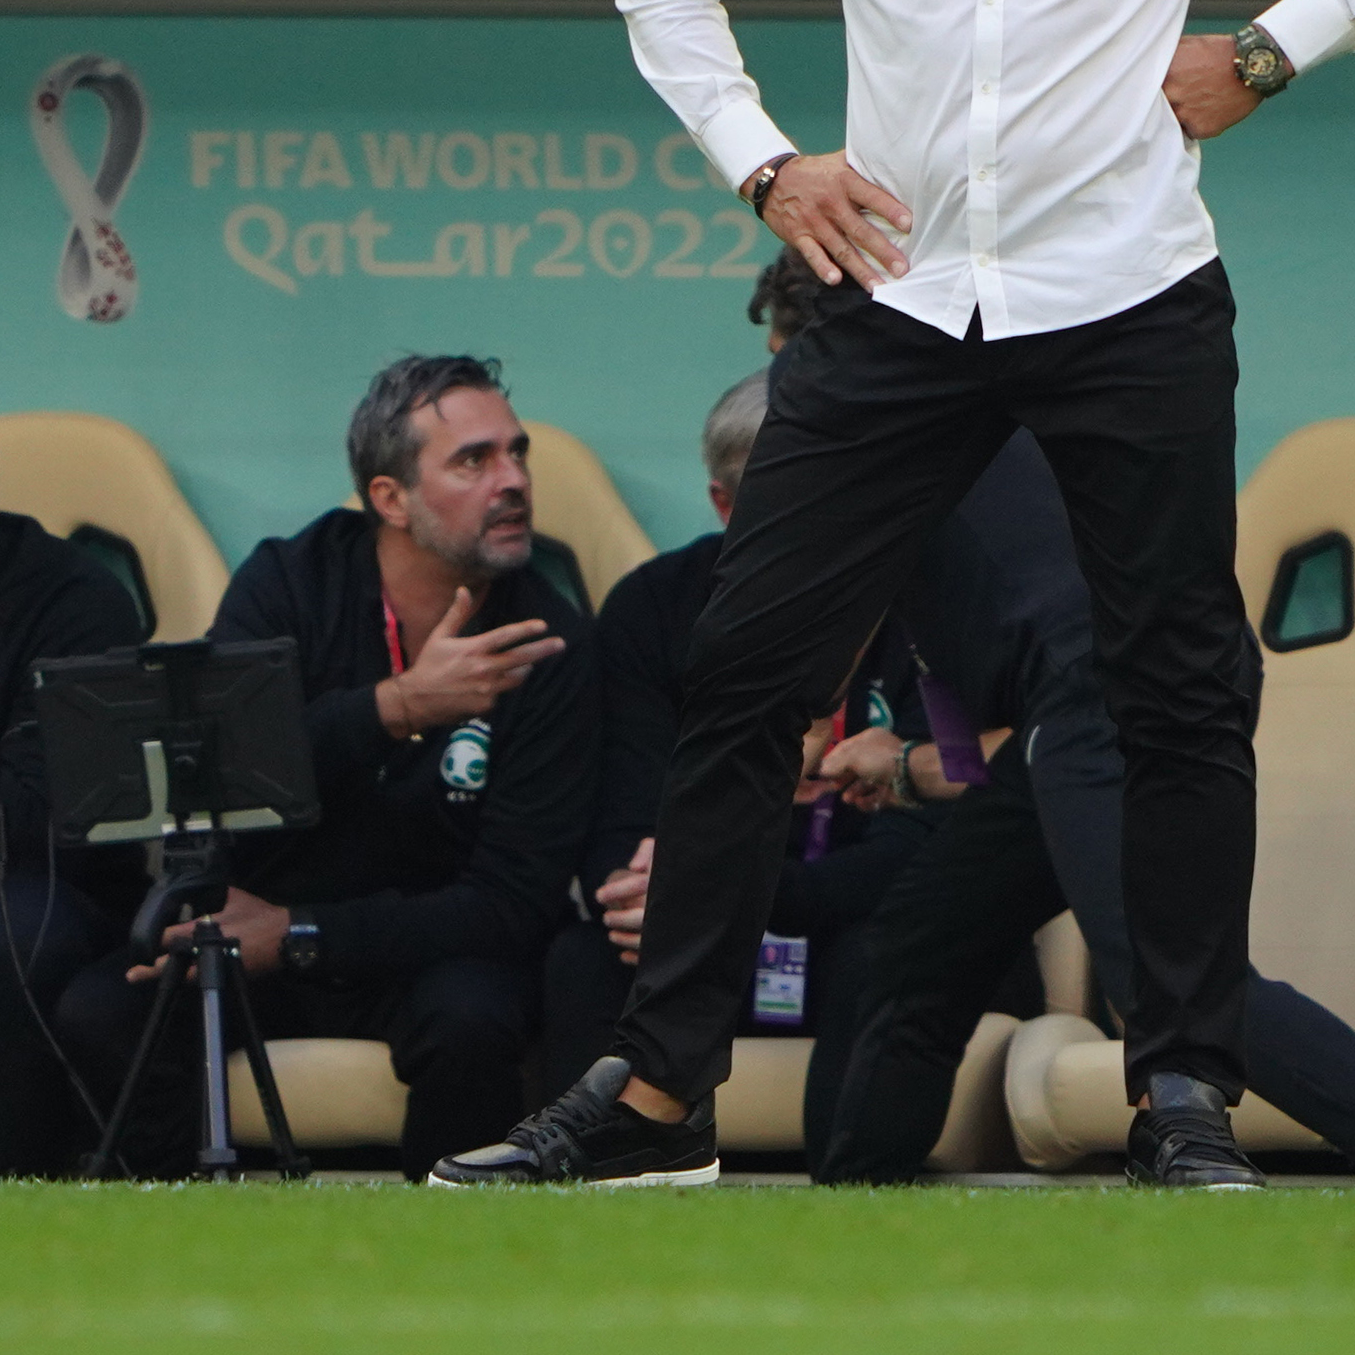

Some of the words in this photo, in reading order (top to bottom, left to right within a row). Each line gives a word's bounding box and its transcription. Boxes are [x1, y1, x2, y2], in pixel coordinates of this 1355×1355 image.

[189, 131, 354, 190] FIFA
[359, 132, 638, 191] WORLD
[223, 203, 762, 298] Qatar2022
